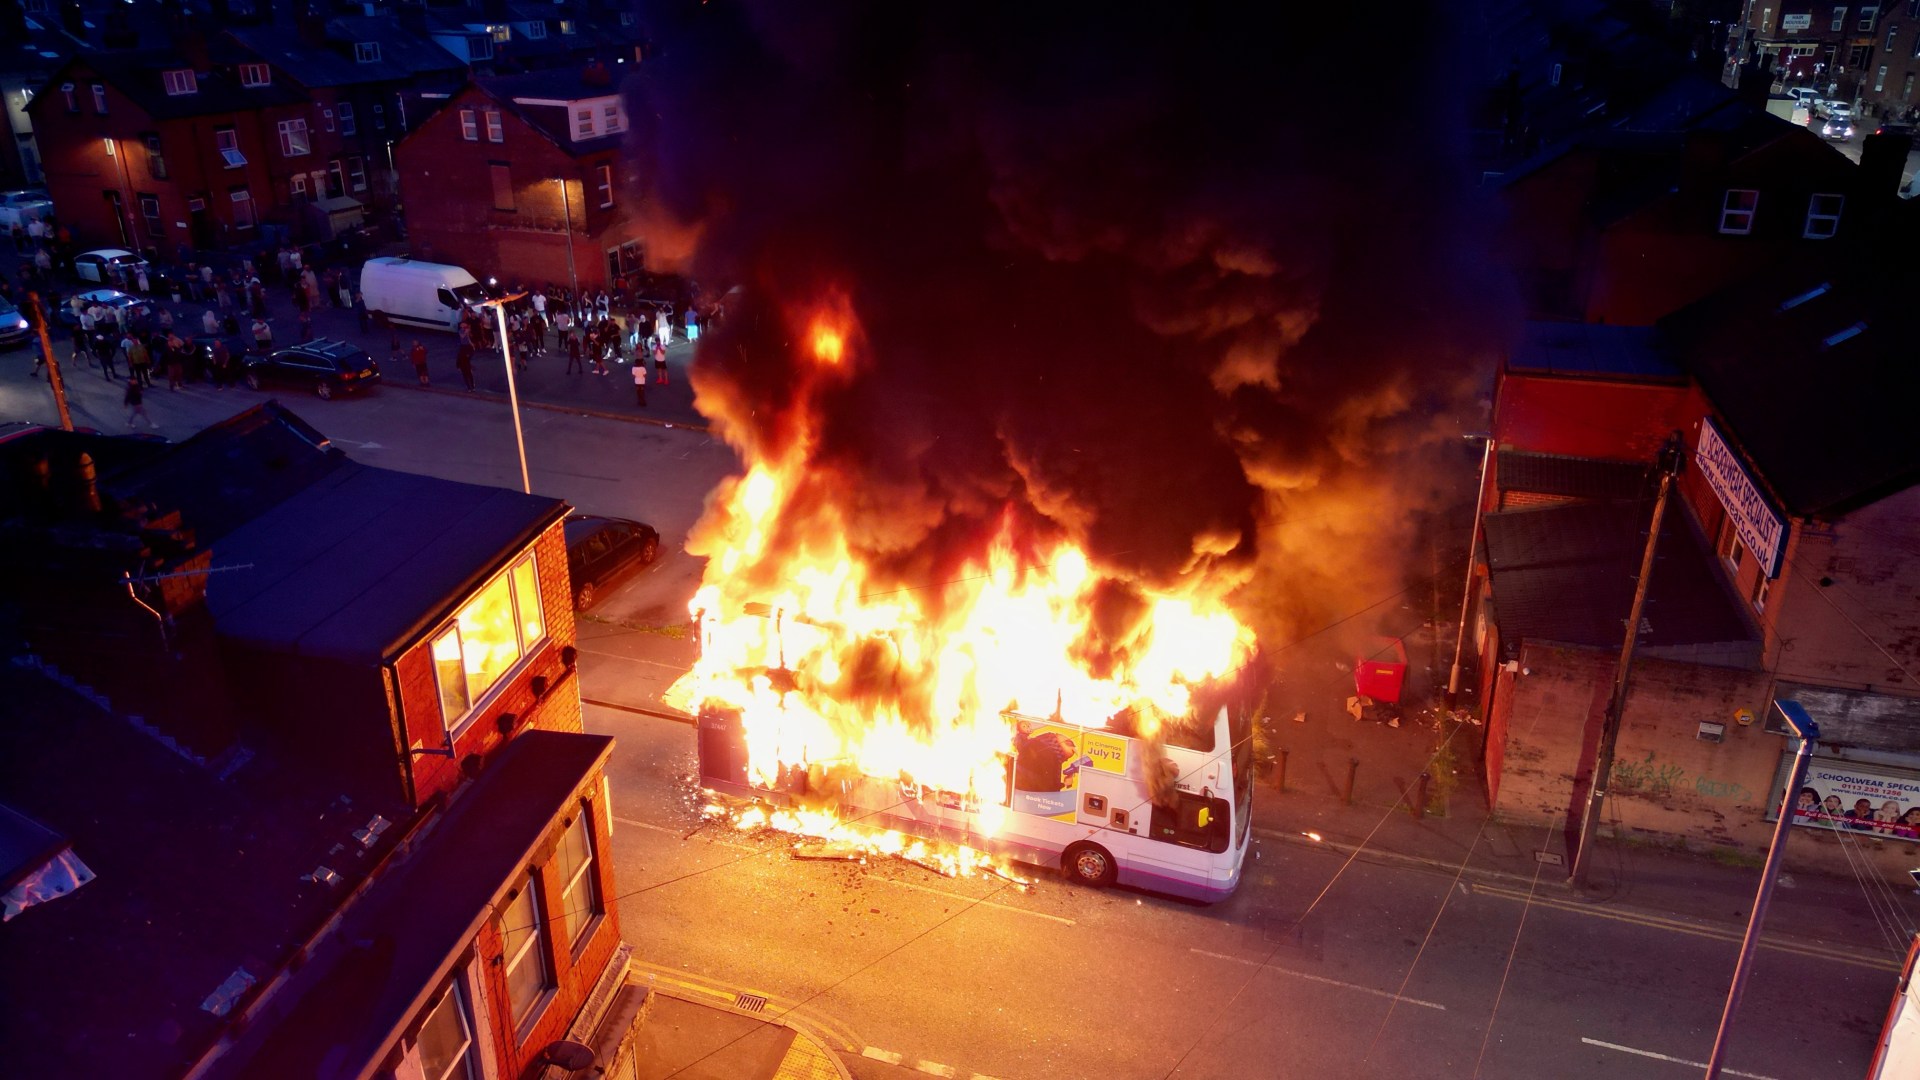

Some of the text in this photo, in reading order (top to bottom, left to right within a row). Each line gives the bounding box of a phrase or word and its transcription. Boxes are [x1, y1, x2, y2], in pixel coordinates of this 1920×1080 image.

[1708, 432, 1776, 548] SCHOOLWEAR SPECIALIST
[1087, 747, 1121, 761] July 12
[1095, 742, 1122, 752] Cinemas
[1816, 772, 1884, 788] SCHOOLWEAR
[1841, 783, 1862, 791] 0113
[1025, 794, 1064, 808] Book Tickets
[1831, 787, 1910, 802] www.uniwears.co.uk
